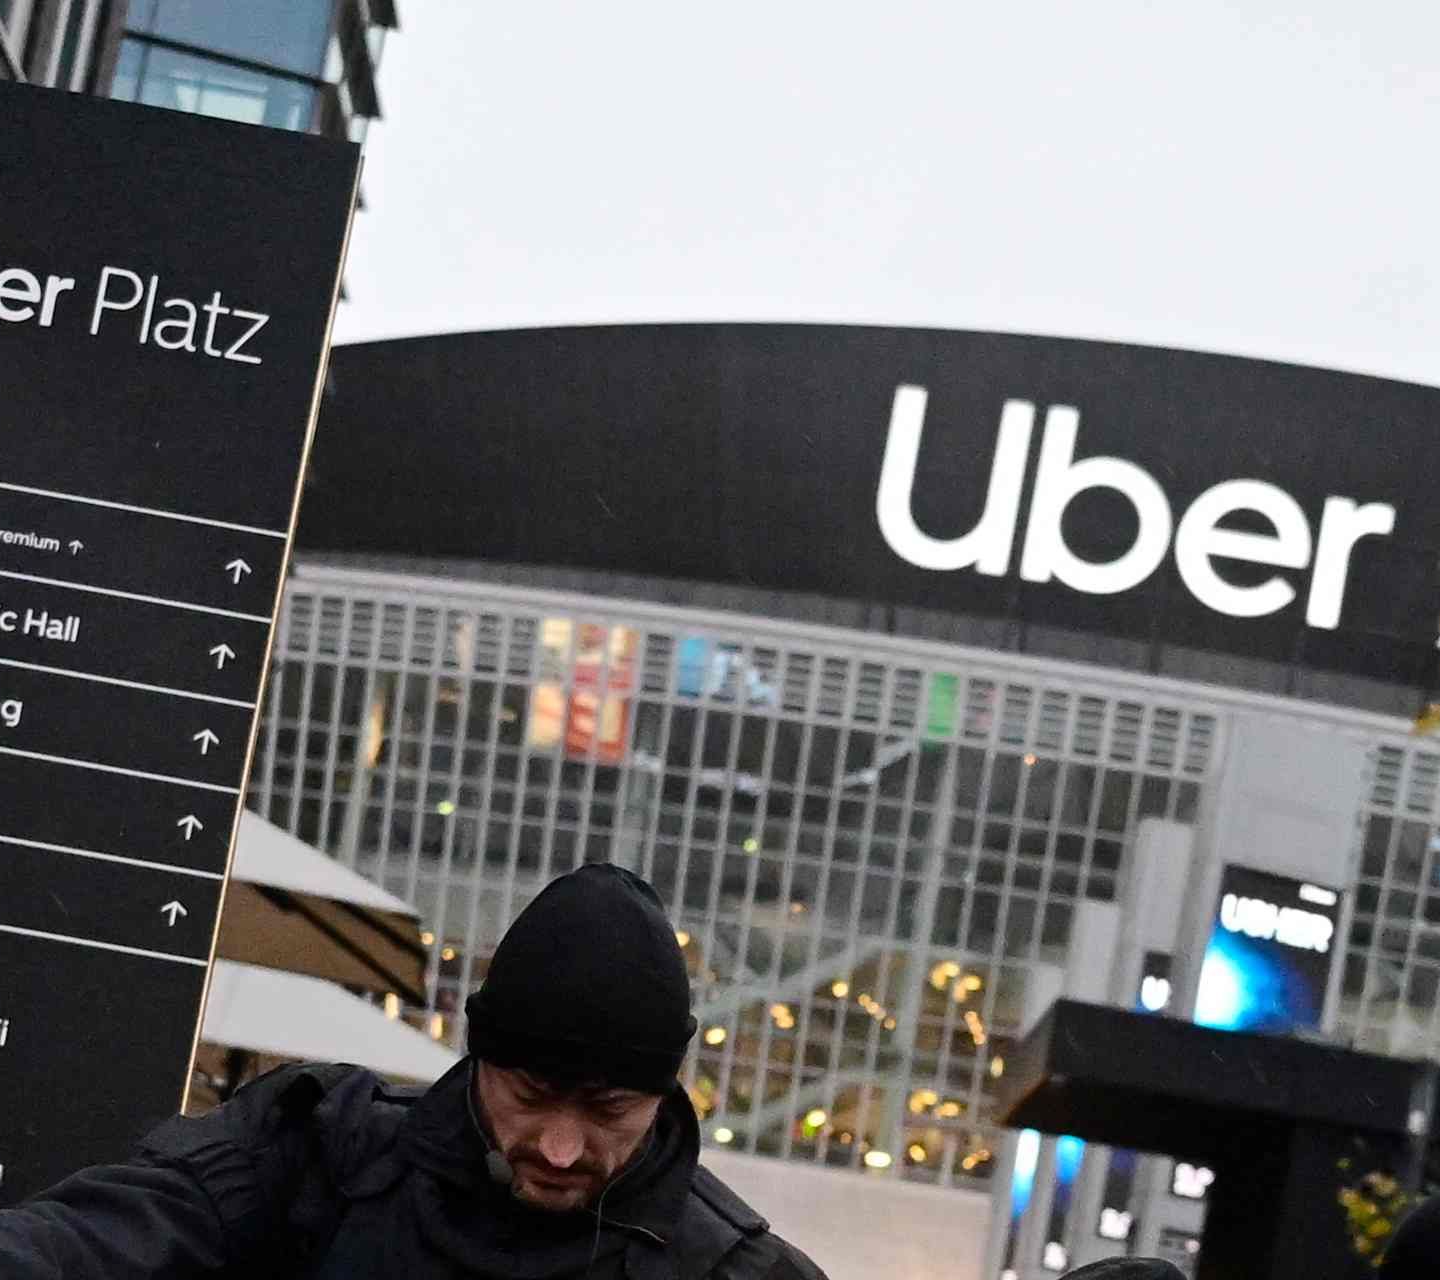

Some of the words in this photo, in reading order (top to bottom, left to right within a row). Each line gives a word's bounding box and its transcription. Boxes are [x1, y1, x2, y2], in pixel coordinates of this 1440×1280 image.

[90, 265, 270, 366] Platz
[876, 385, 1396, 630] Uber
[22, 608, 82, 645] Hall
